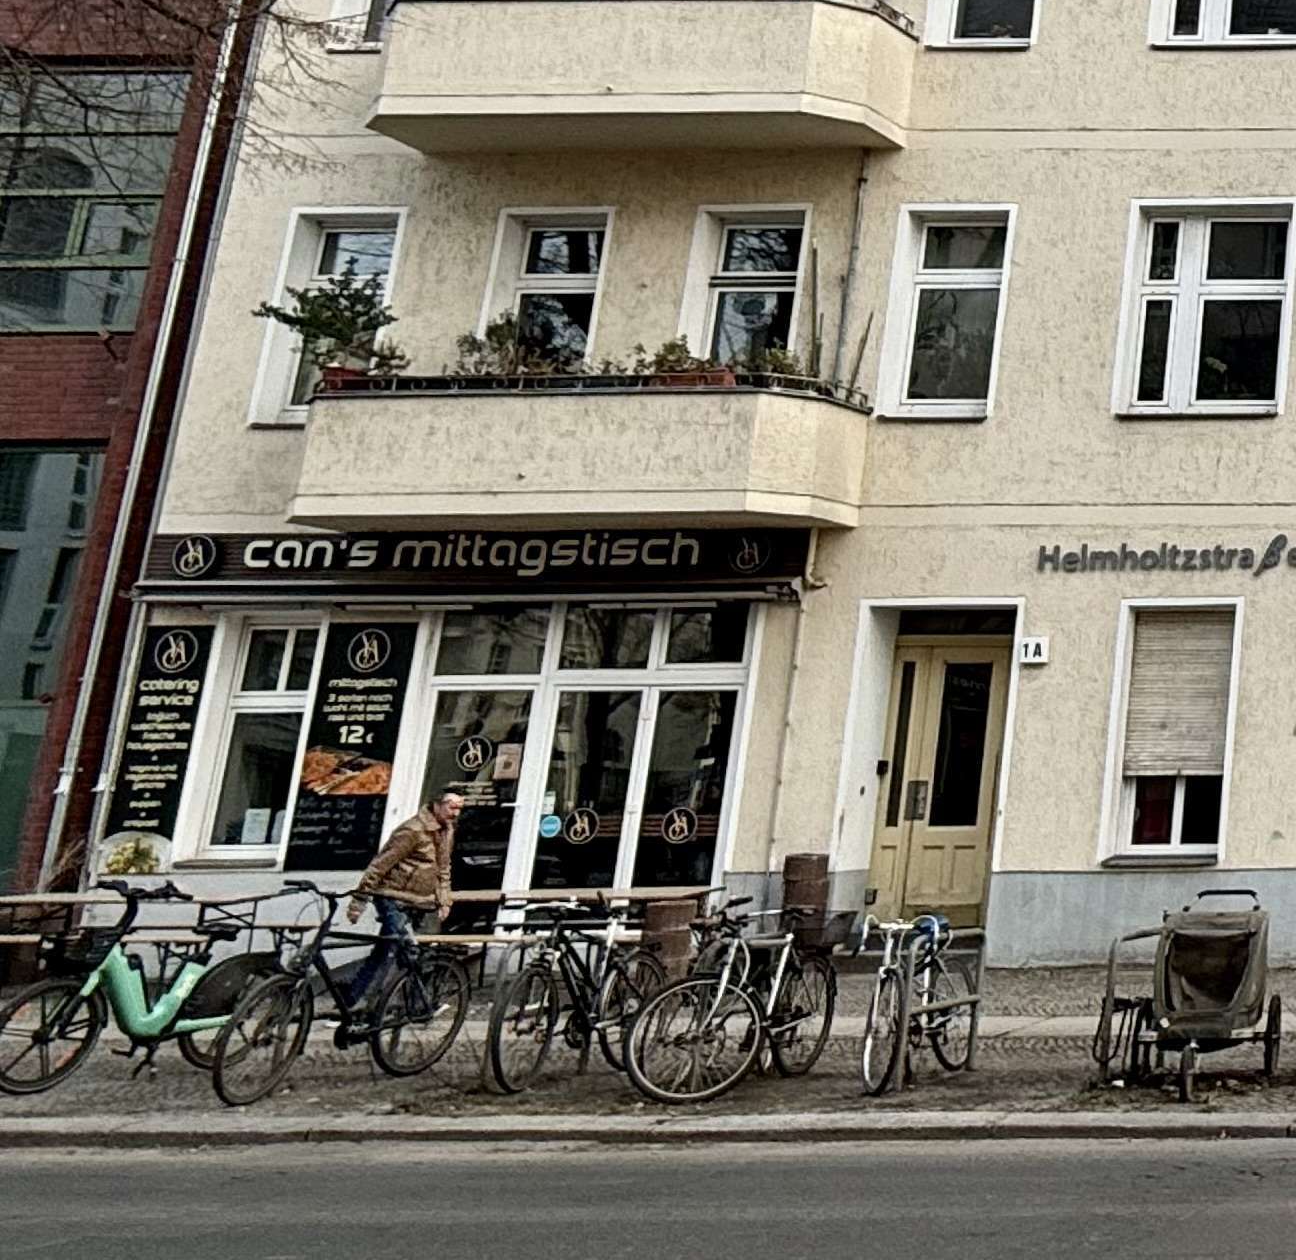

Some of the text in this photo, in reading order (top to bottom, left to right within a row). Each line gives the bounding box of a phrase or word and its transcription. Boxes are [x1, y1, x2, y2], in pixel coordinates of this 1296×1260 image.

[243, 532, 700, 576] can's mittagstisch
[1023, 642, 1042, 658] 1A
[139, 678, 200, 693] catering
[138, 694, 194, 706] service
[339, 725, 365, 744] 12
